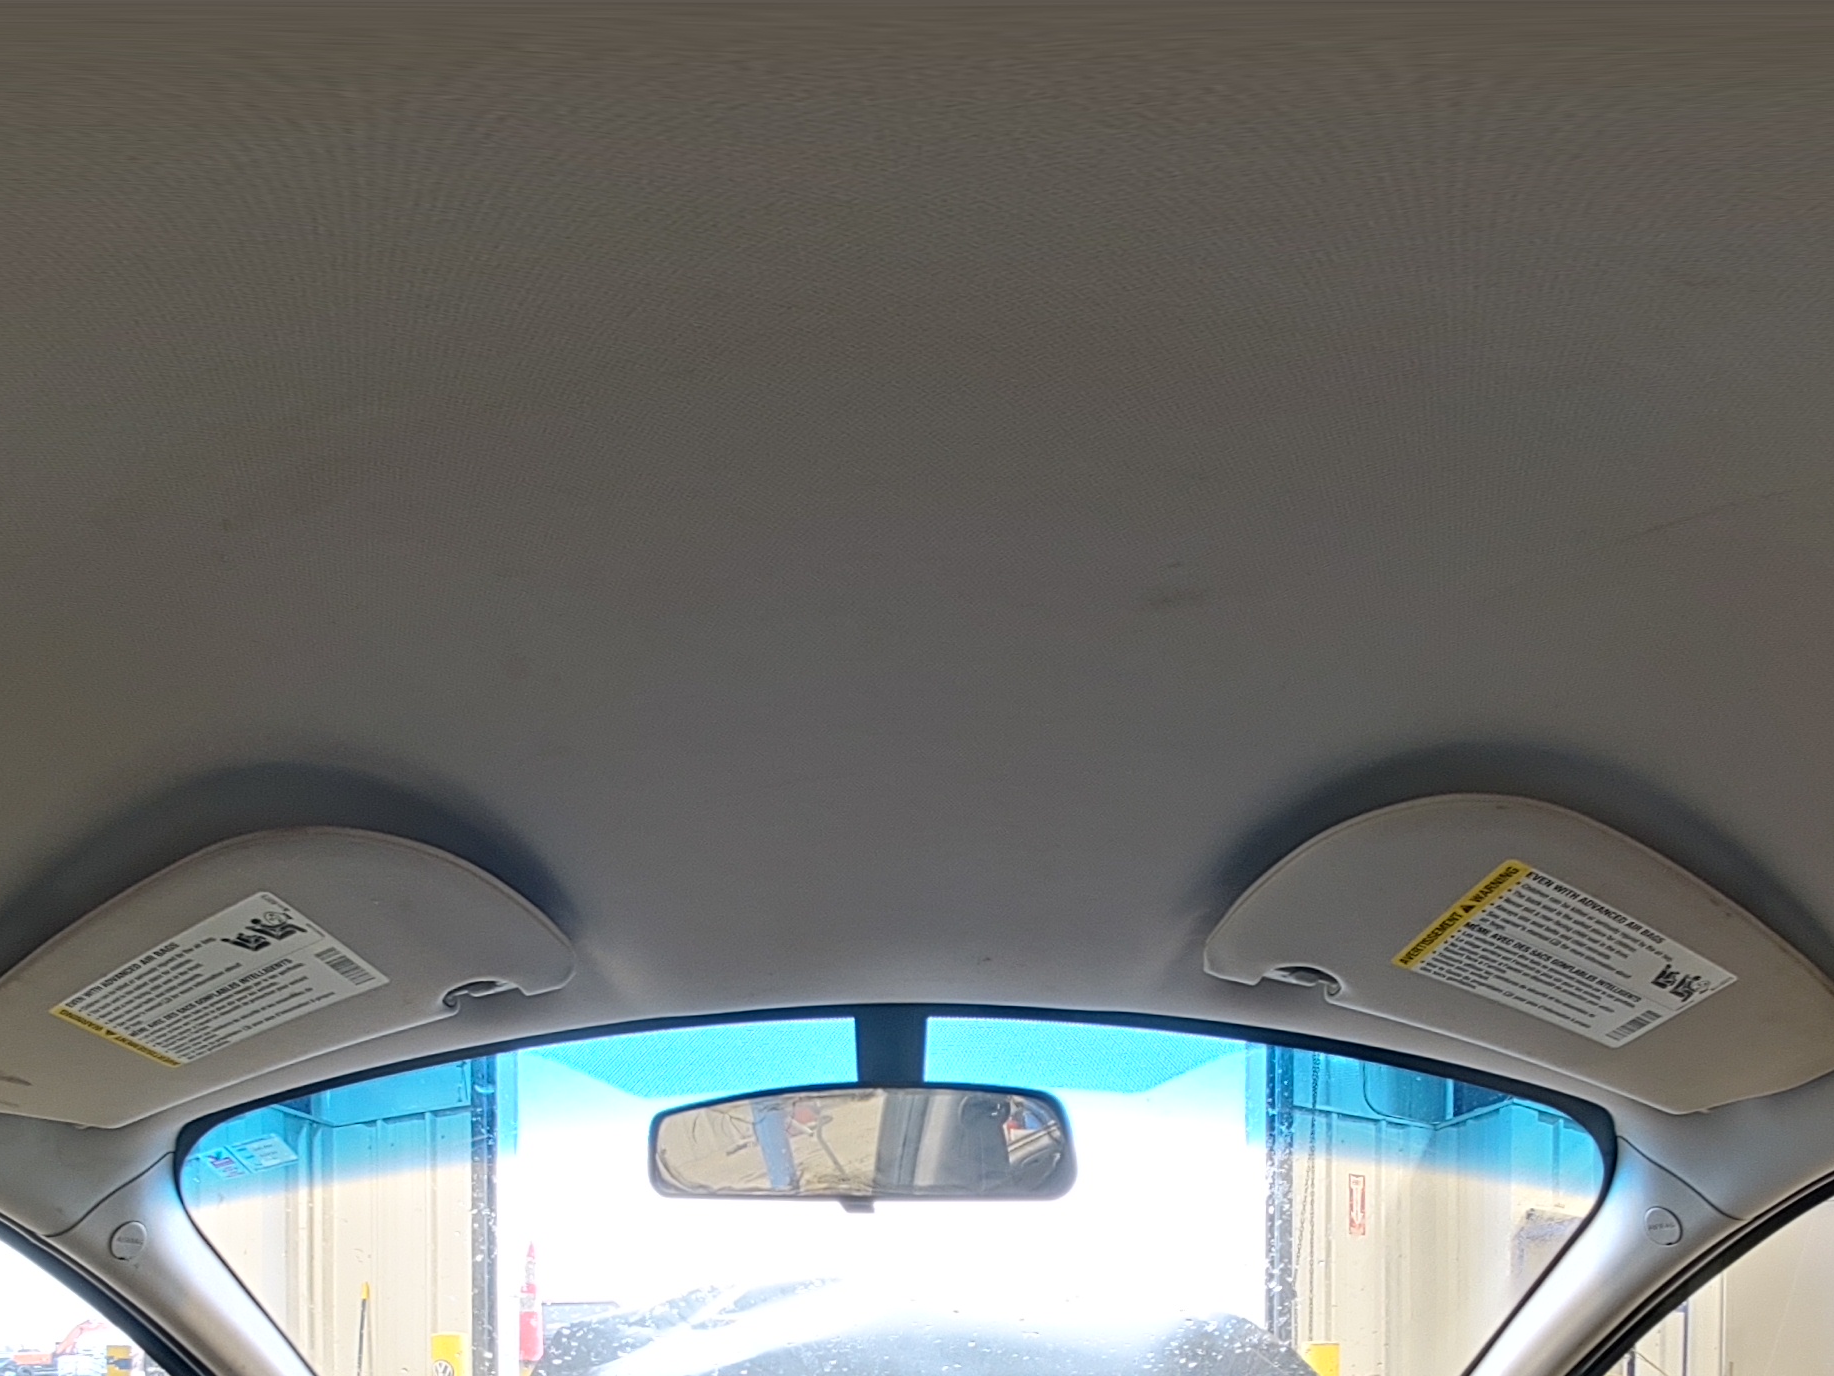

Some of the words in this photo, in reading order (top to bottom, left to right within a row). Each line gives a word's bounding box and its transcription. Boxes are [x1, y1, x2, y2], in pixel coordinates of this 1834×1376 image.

[1469, 866, 1519, 904] WARNING
[1526, 871, 1553, 886] EVEN
[1552, 884, 1579, 899] WITH
[1577, 897, 1627, 923] ADVANCED
[1625, 921, 1642, 931] AIR
[1639, 929, 1665, 943] BAGS
[1397, 912, 1464, 964] AVERTISSEMENT
